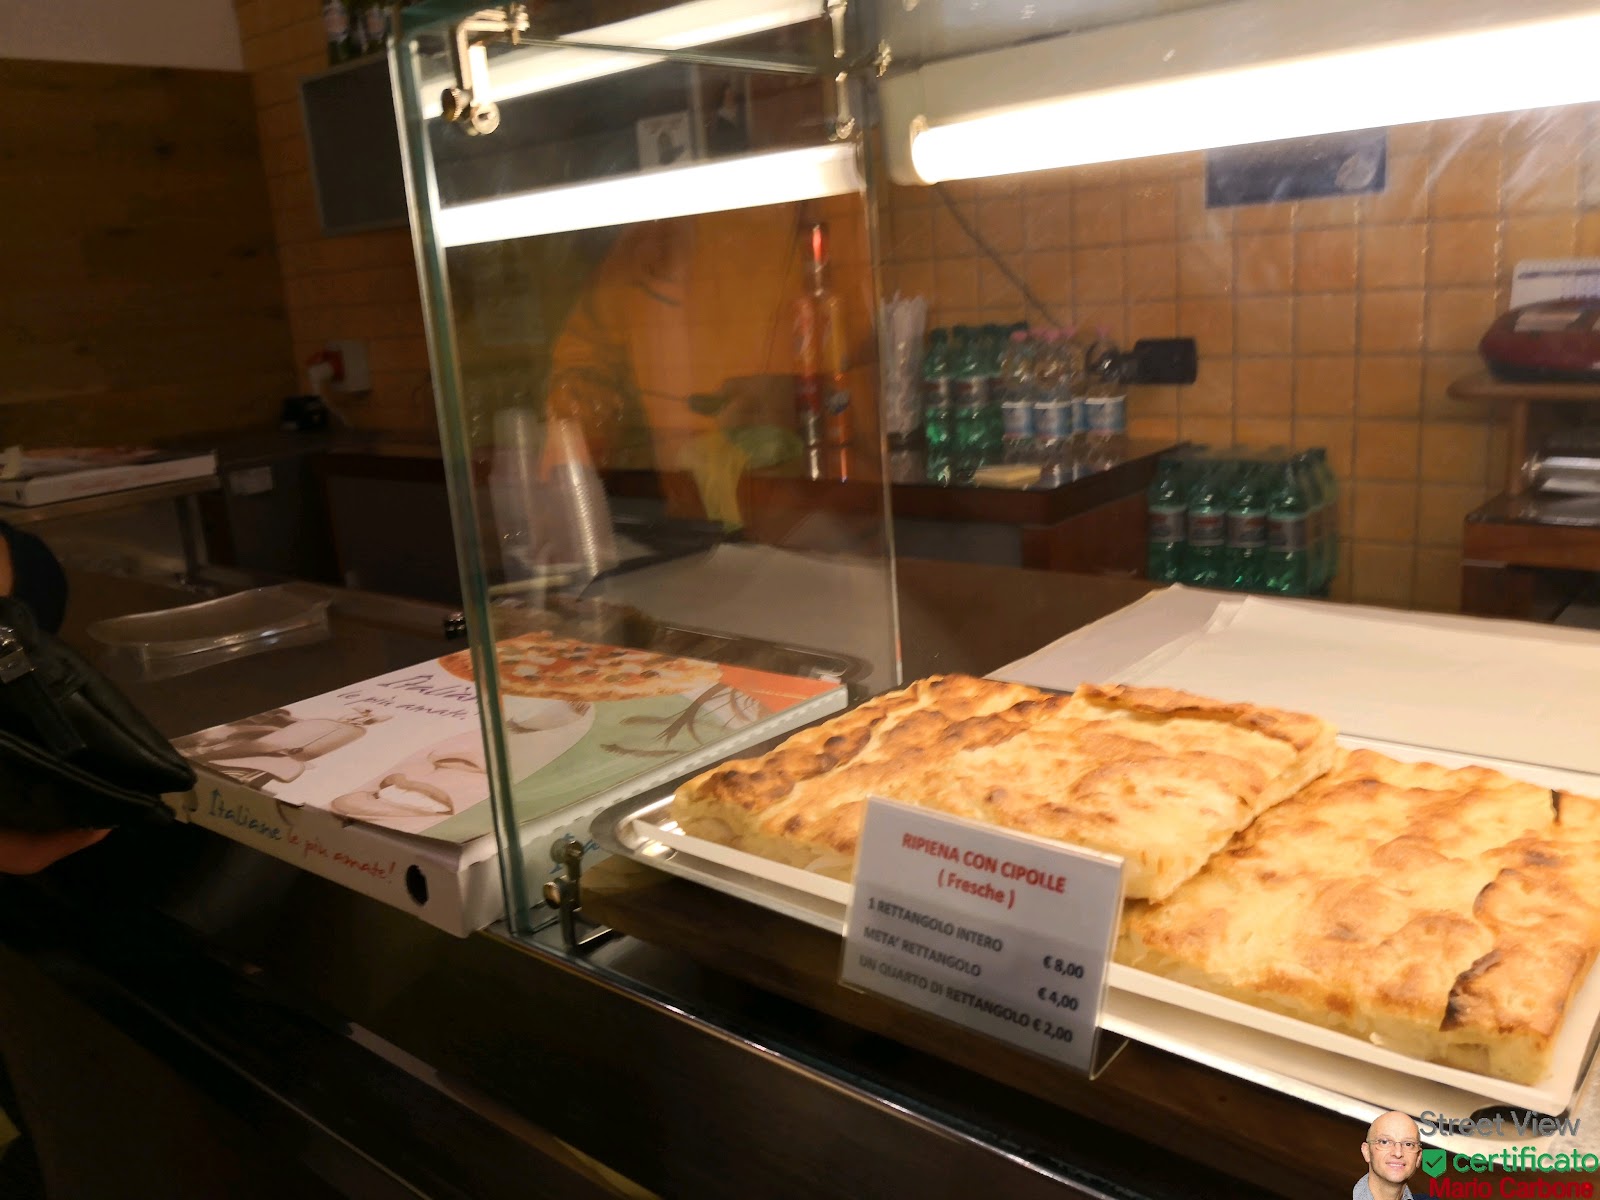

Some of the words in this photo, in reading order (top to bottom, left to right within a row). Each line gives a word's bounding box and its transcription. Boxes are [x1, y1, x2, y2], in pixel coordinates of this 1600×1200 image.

[207, 788, 283, 841] Italiane
[287, 829, 300, 846] le
[304, 837, 329, 858] più
[333, 852, 397, 884] amate!
[902, 832, 960, 862] RIPIENA
[963, 850, 998, 874] CON
[1000, 860, 1067, 895] CIPOLLE
[868, 897, 875, 910] 1
[877, 900, 955, 936] RETTANGOLO
[956, 927, 1004, 953] INTERO
[1054, 958, 1085, 979] 8,00
[859, 954, 877, 971] UN
[878, 962, 928, 989] QUARTO
[930, 981, 945, 996] DI
[945, 986, 1030, 1027] RETTANGOLO
[1044, 1021, 1073, 1043] 2,00
[901, 939, 981, 977] RETTANGOLO
[1049, 991, 1079, 1011] 4,00
